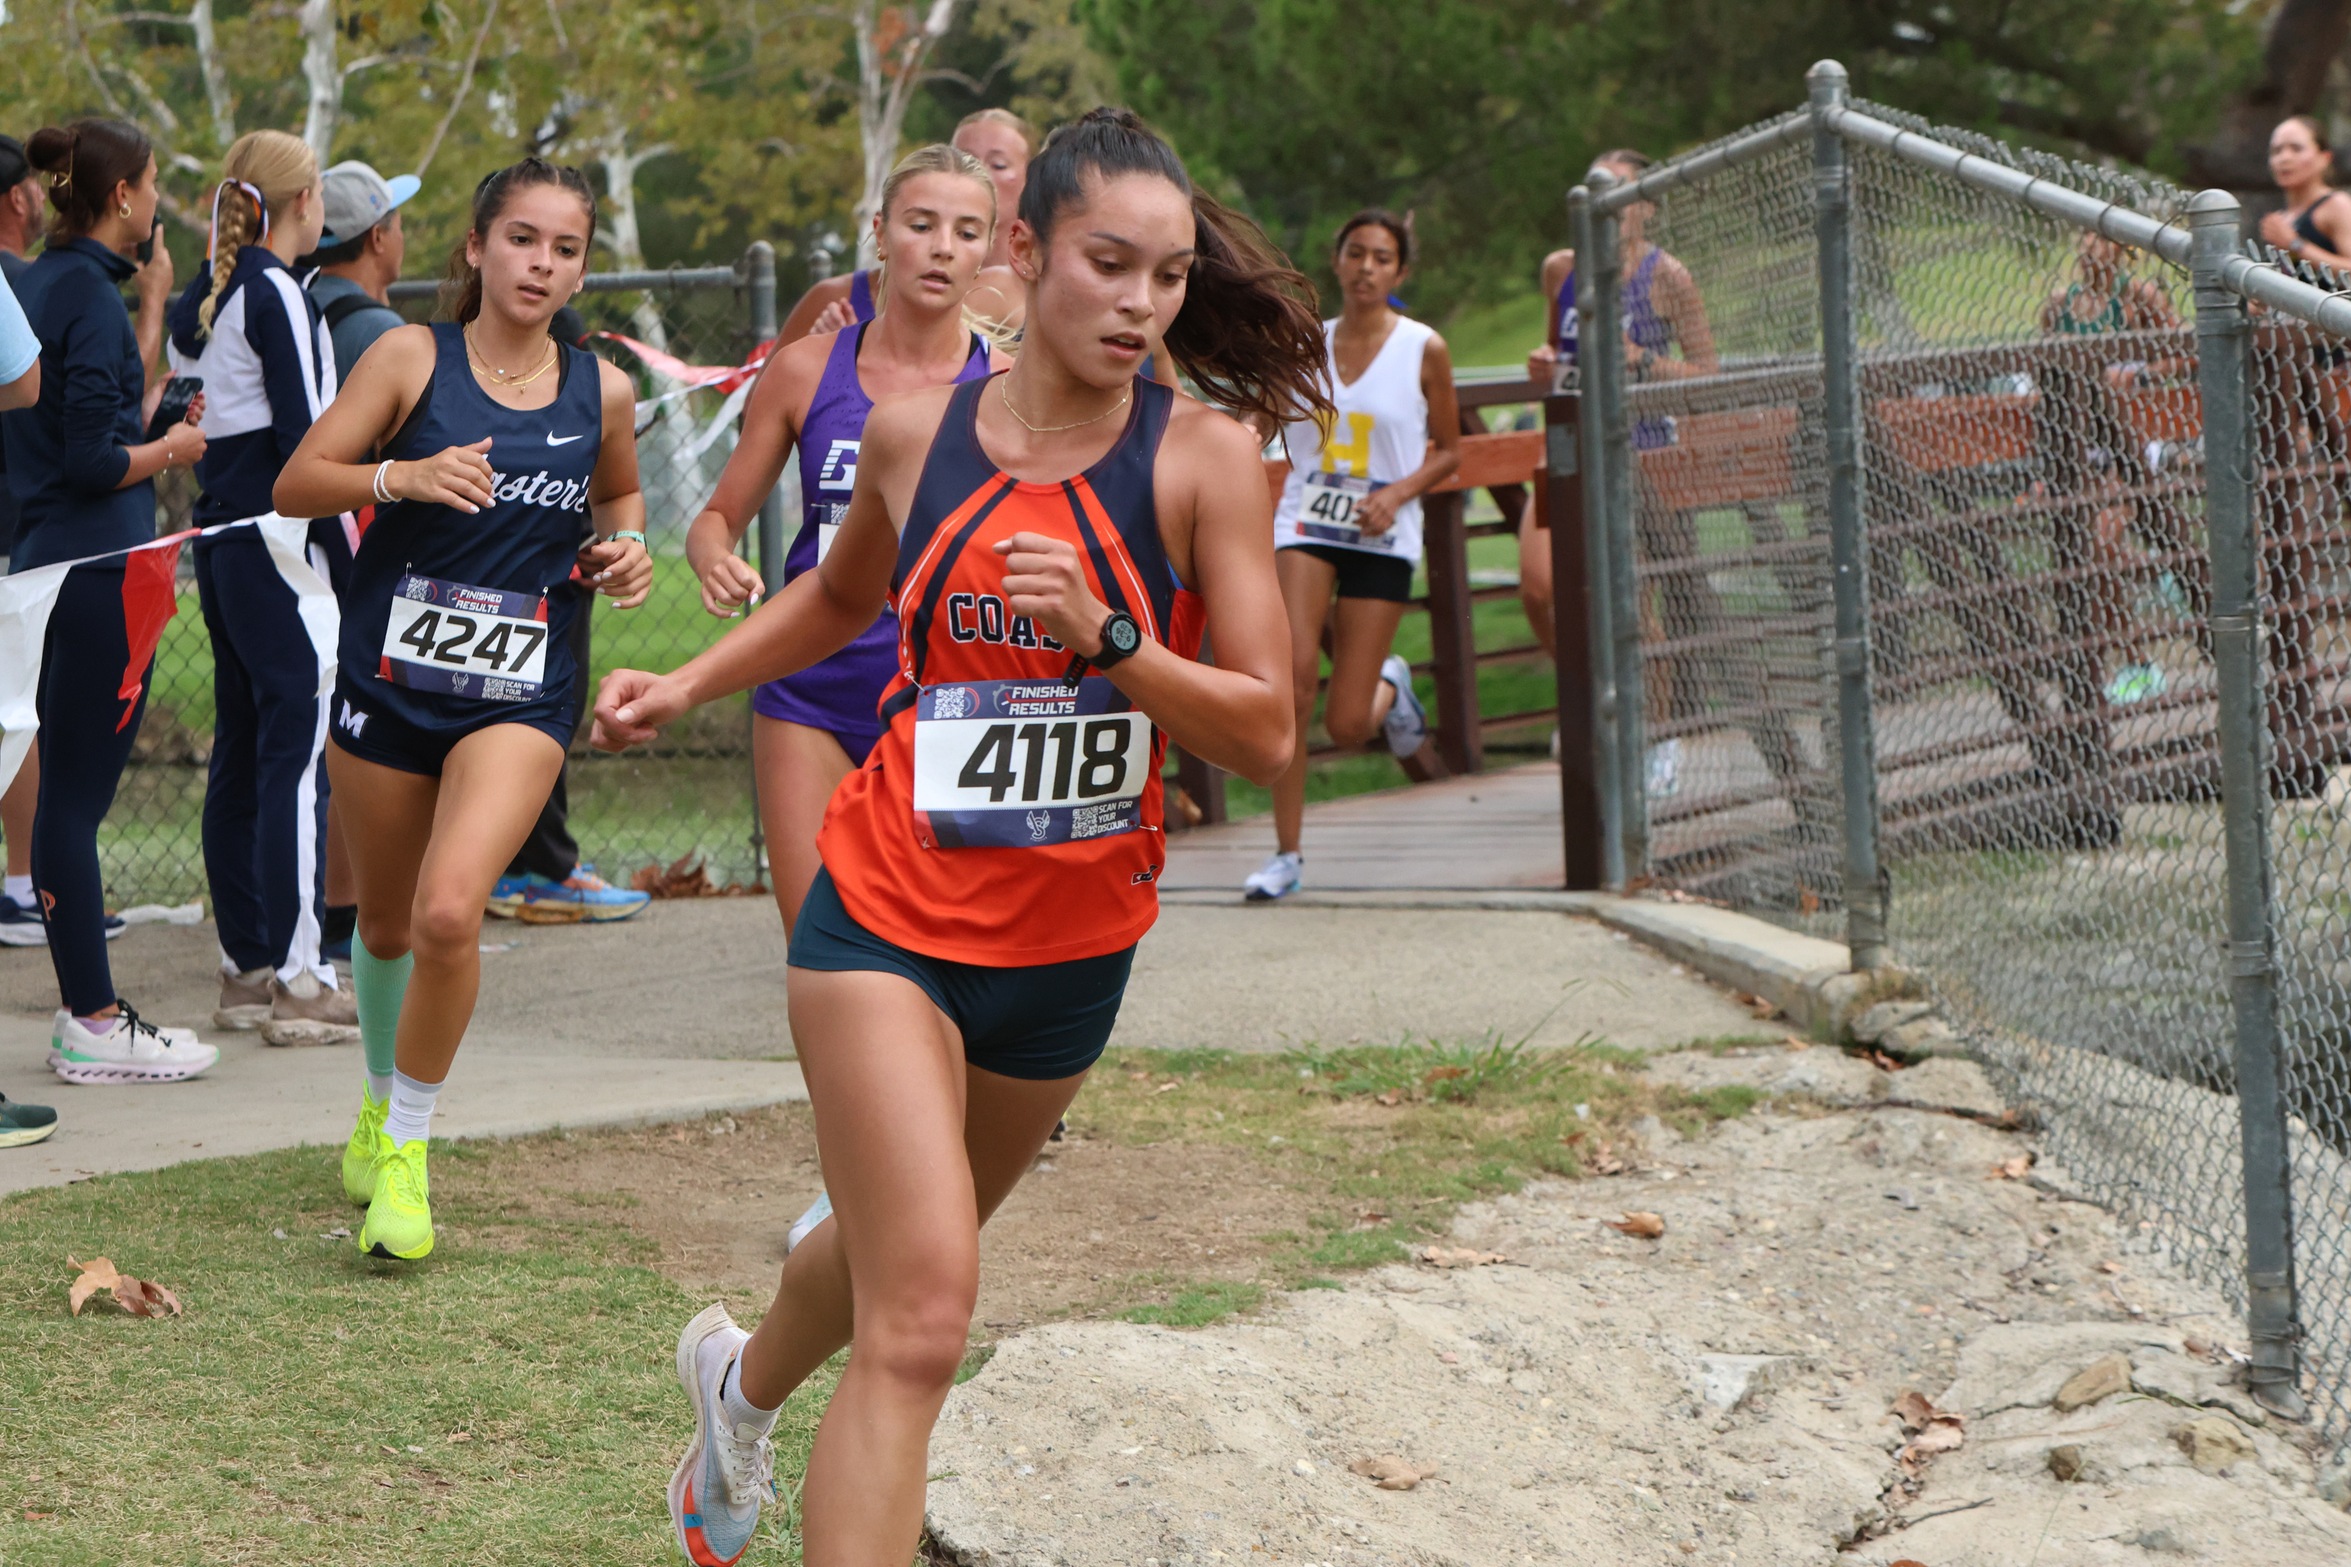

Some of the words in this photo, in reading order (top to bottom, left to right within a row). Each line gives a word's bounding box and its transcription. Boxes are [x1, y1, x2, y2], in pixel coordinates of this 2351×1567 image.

[1314, 410, 1375, 478] H
[819, 440, 861, 491] G
[1310, 492, 1353, 522] 40
[455, 600, 500, 614] RESULTS
[460, 589, 503, 603] FINISHED
[947, 593, 1066, 653] COA
[400, 609, 546, 673] 4247
[506, 680, 522, 689] SCAN
[523, 683, 535, 691] FOR
[1012, 685, 1079, 699] FINISHED
[339, 698, 369, 739] M
[1009, 701, 1076, 715] RESULTS
[958, 718, 1131, 802] 4118
[1098, 803, 1116, 814] SCAN
[1118, 801, 1133, 810] FOR
[1099, 812, 1116, 823] YOUR
[1098, 819, 1129, 833] DISCOUNT
[39, 888, 56, 921] P
